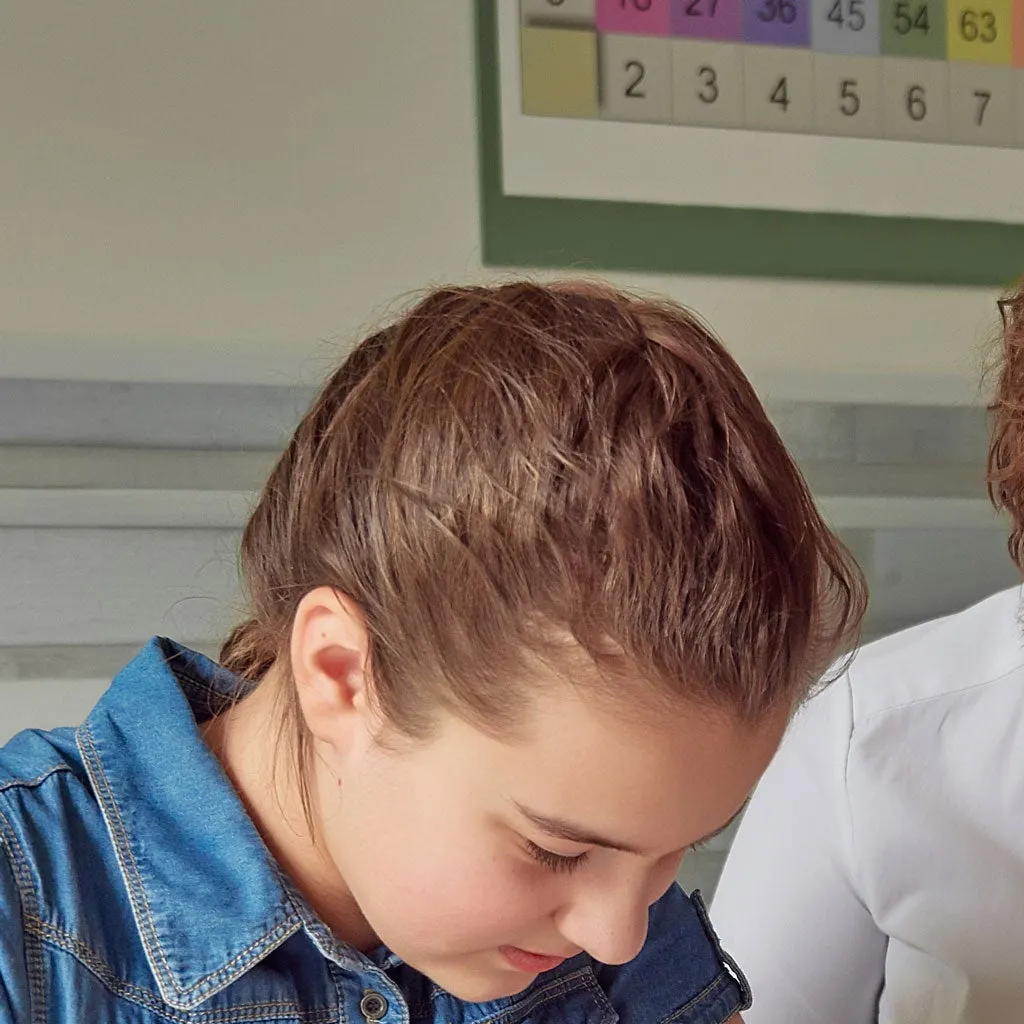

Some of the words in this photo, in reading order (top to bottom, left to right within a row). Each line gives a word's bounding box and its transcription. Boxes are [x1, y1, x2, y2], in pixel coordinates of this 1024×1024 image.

[756, 0, 798, 25] 36
[827, 0, 865, 32] 45
[894, 2, 930, 35] 54
[959, 9, 997, 43] 63
[624, 60, 645, 98] 2
[697, 66, 719, 104] 3
[769, 76, 790, 112] 4
[840, 79, 860, 117] 5
[906, 85, 927, 122] 6
[973, 90, 992, 126] 7
